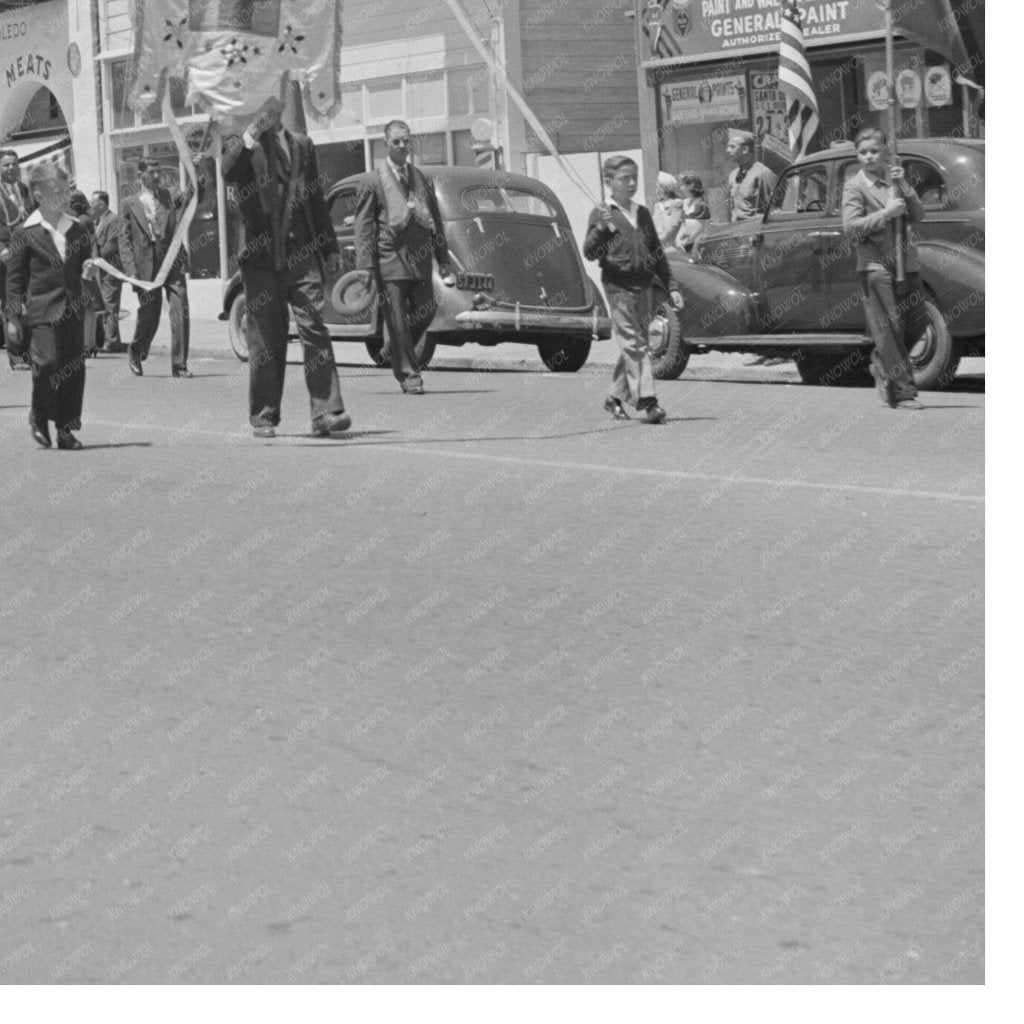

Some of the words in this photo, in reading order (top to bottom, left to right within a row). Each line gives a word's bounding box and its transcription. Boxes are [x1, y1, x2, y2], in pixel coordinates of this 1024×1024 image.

[711, 11, 782, 37] GENERAL
[797, 0, 849, 24] PAINT
[722, 32, 782, 48] AUTHORIZE
[802, 23, 841, 37] EALER
[6, 53, 52, 88] MEATS
